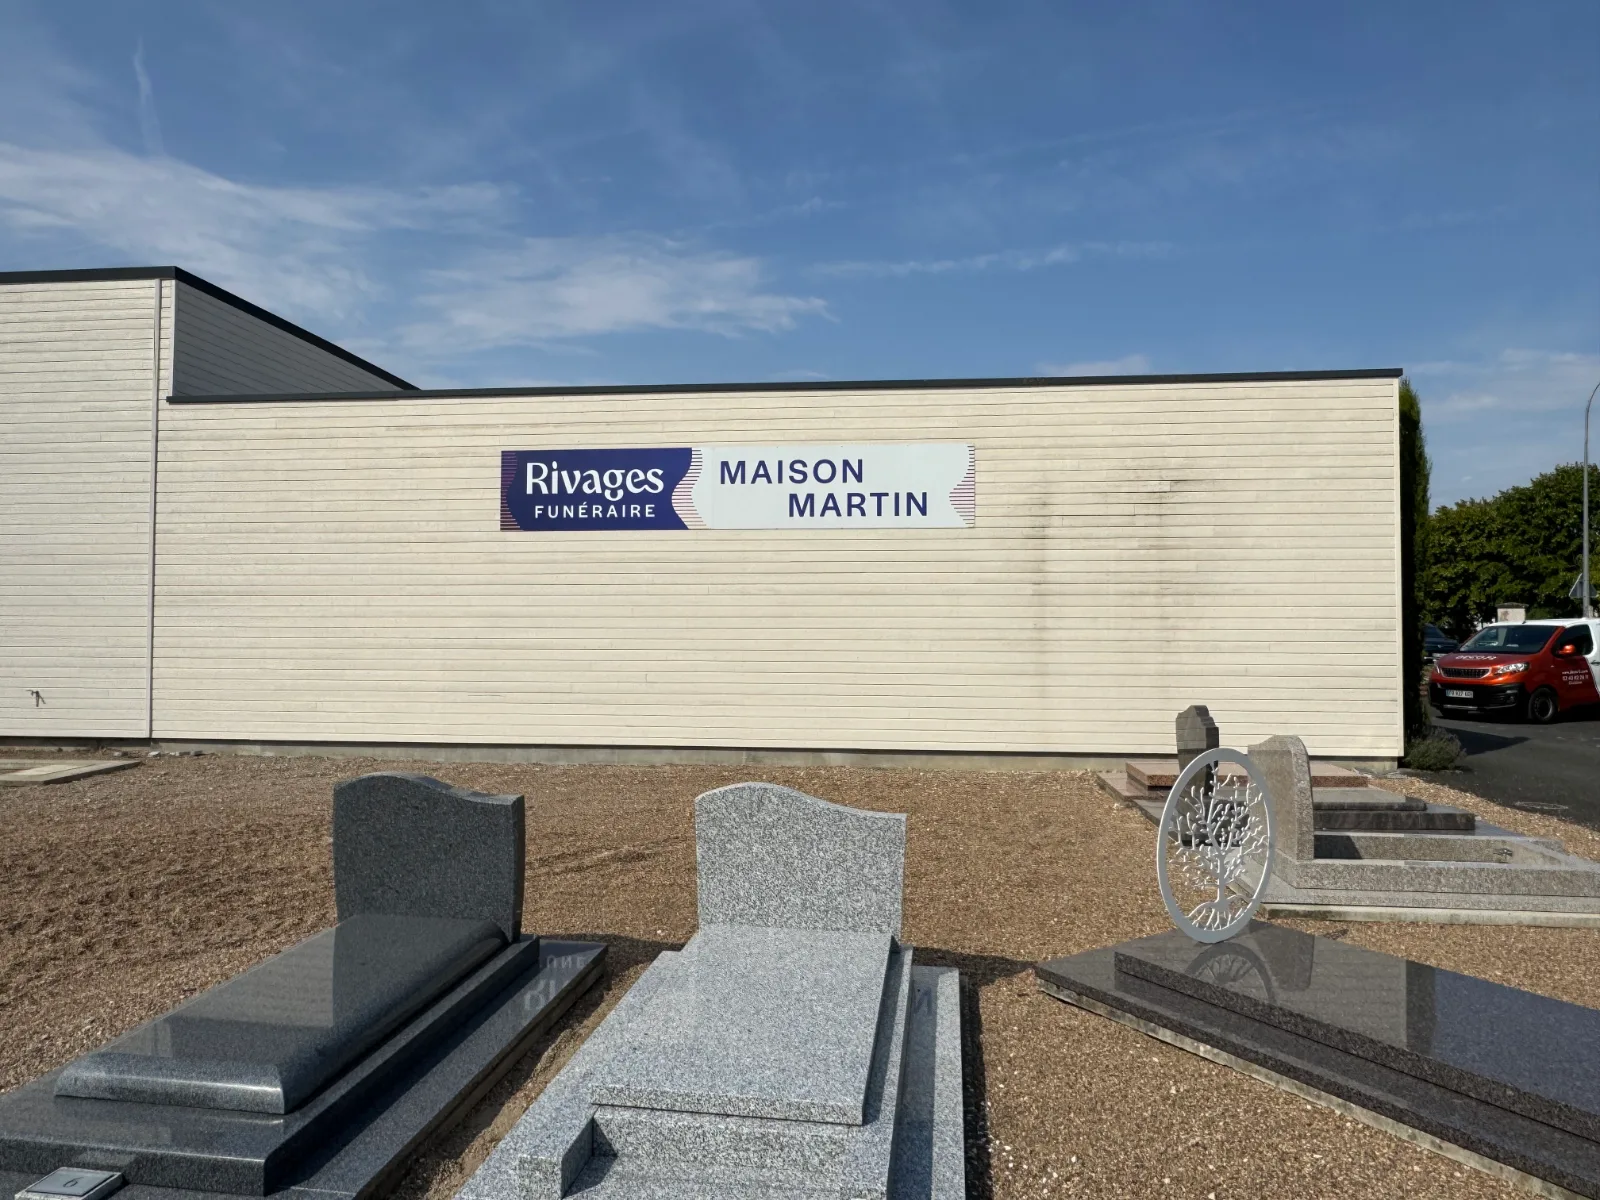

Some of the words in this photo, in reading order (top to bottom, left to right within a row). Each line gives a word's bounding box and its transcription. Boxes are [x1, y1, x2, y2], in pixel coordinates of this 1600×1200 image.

[526, 460, 664, 501] Rivages
[720, 458, 863, 484] MAISON
[535, 502, 656, 518] FUNÉRAIRE
[788, 492, 928, 517] MARTIN
